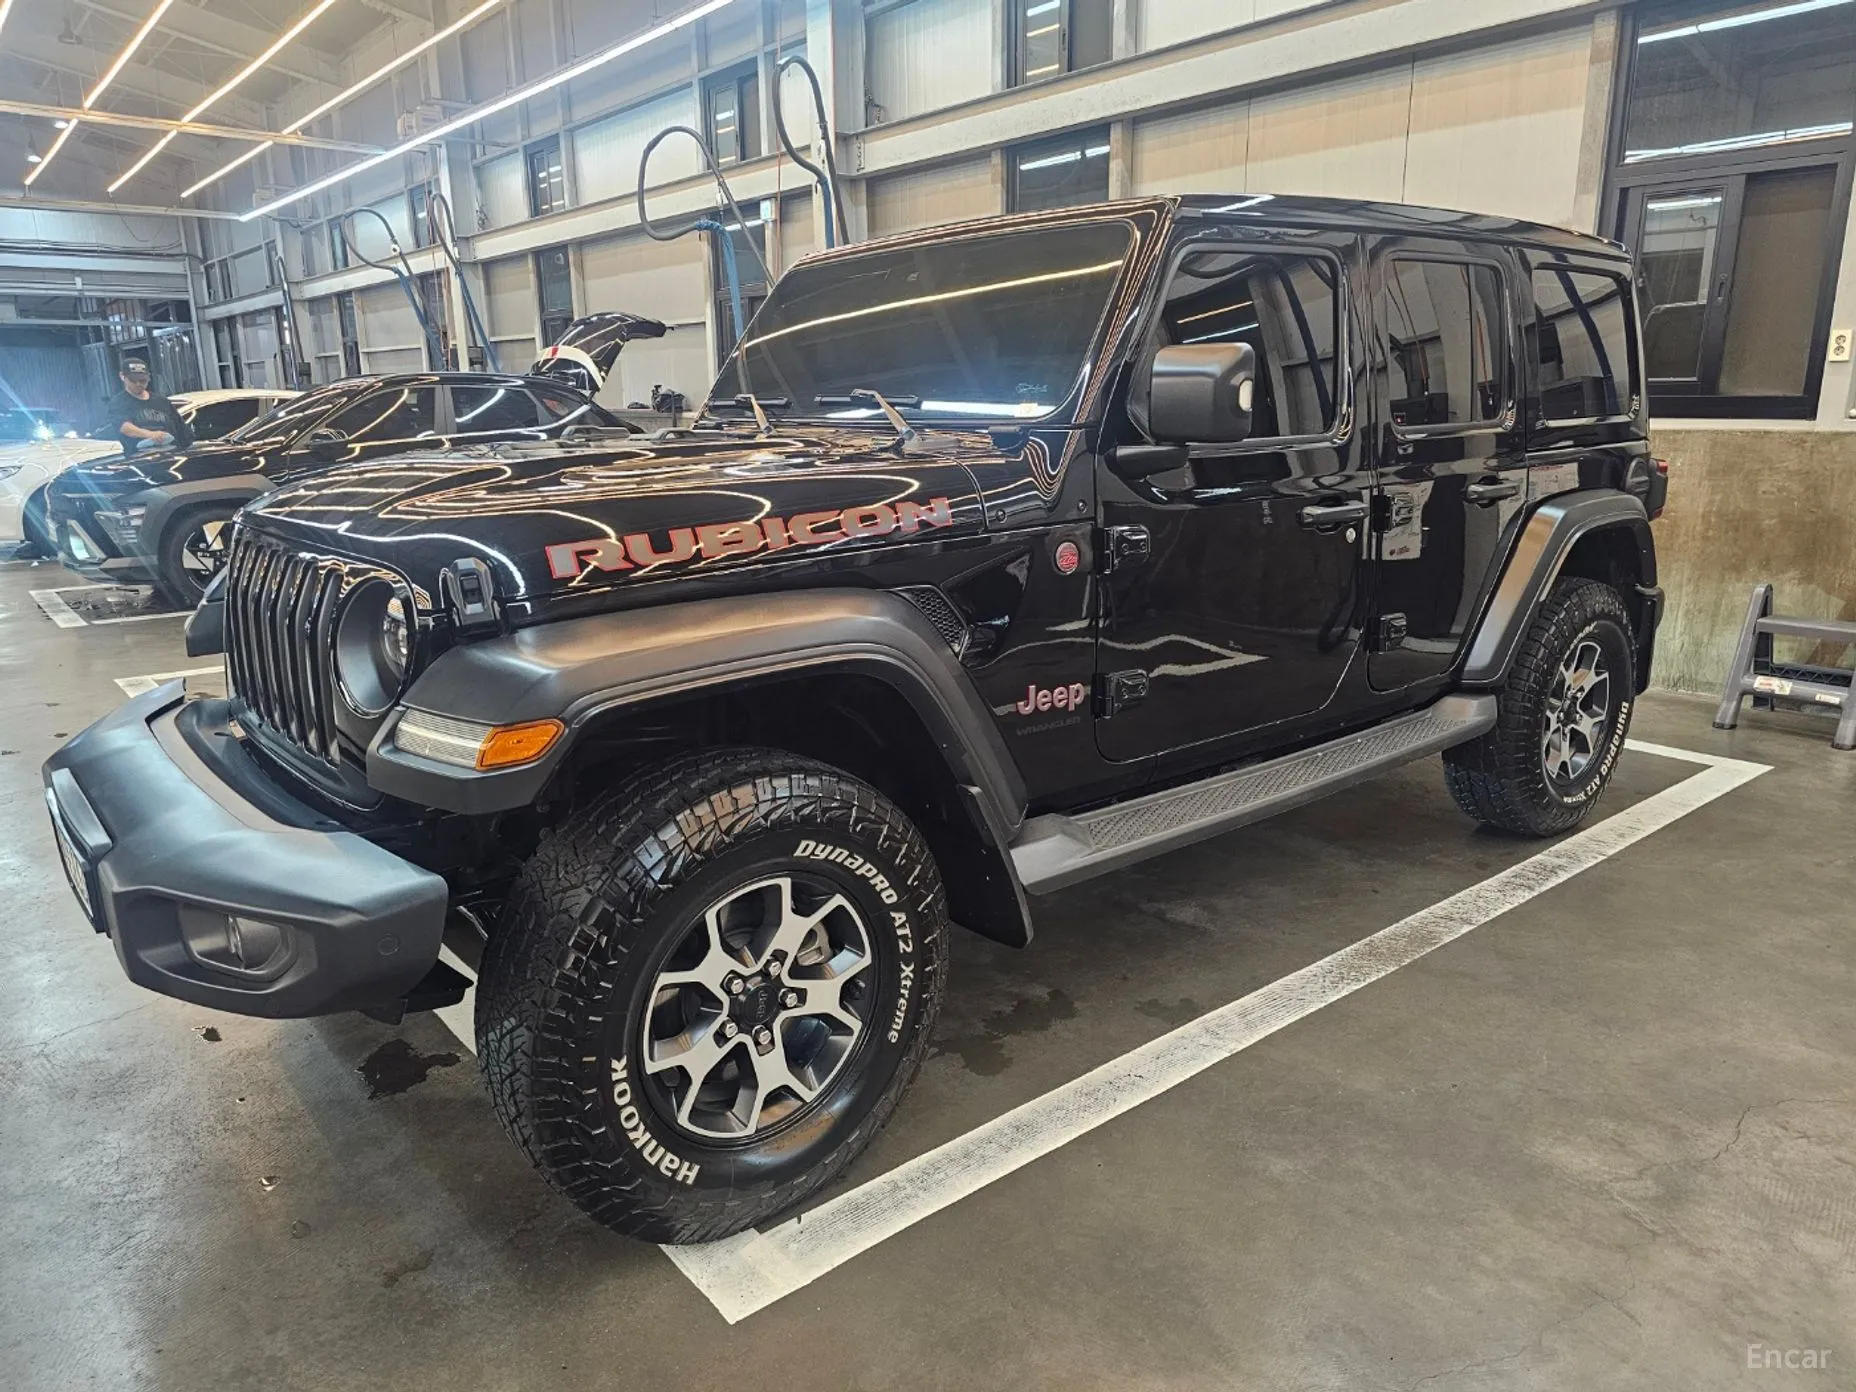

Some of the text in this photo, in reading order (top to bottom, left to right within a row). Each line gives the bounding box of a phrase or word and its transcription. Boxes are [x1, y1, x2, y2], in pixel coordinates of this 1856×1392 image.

[544, 497, 953, 580] RUBICON
[1016, 683, 1085, 715] Jeep
[890, 911, 913, 954] AT2
[887, 961, 915, 1044] Xtreme
